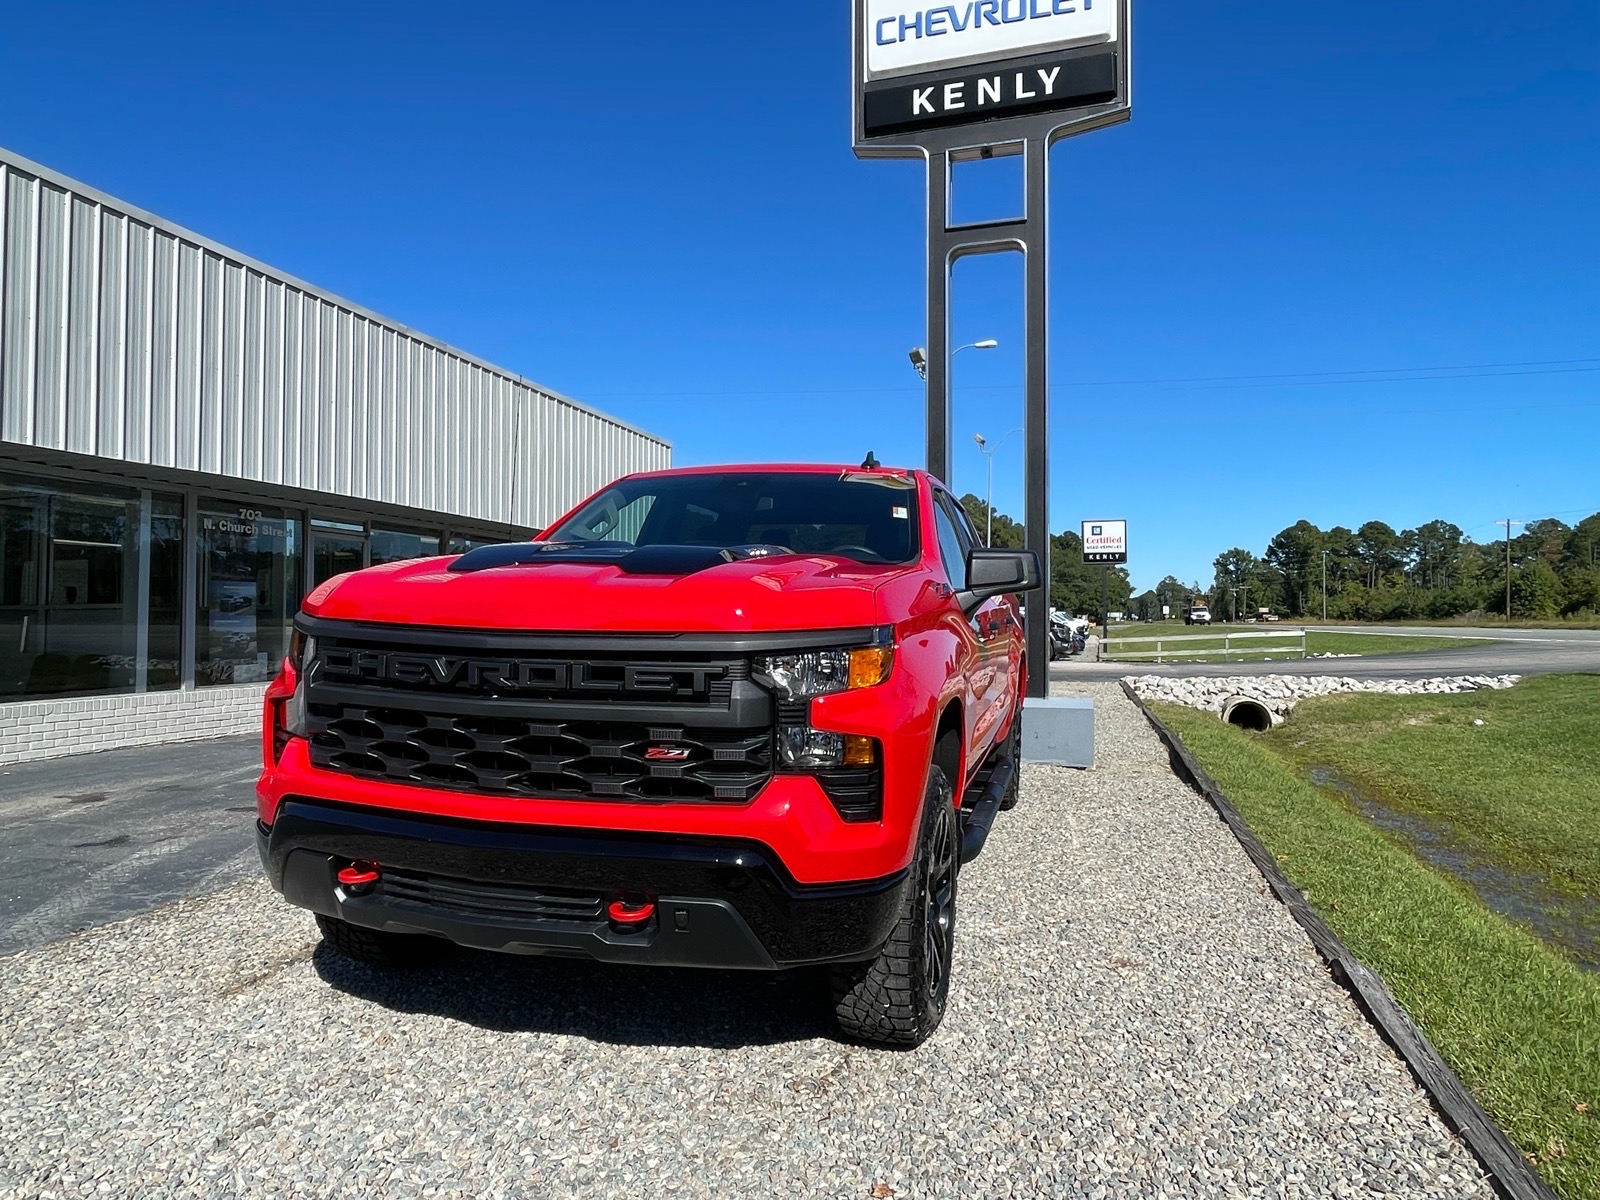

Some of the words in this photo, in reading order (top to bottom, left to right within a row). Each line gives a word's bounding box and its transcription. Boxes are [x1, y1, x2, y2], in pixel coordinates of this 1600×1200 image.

[912, 66, 1061, 115] KENLY
[239, 508, 262, 520] 703
[203, 518, 216, 530] N.
[219, 520, 259, 535] Church
[261, 525, 293, 538] Street
[1086, 536, 1122, 544] Certified
[320, 650, 725, 693] CHEVROLET
